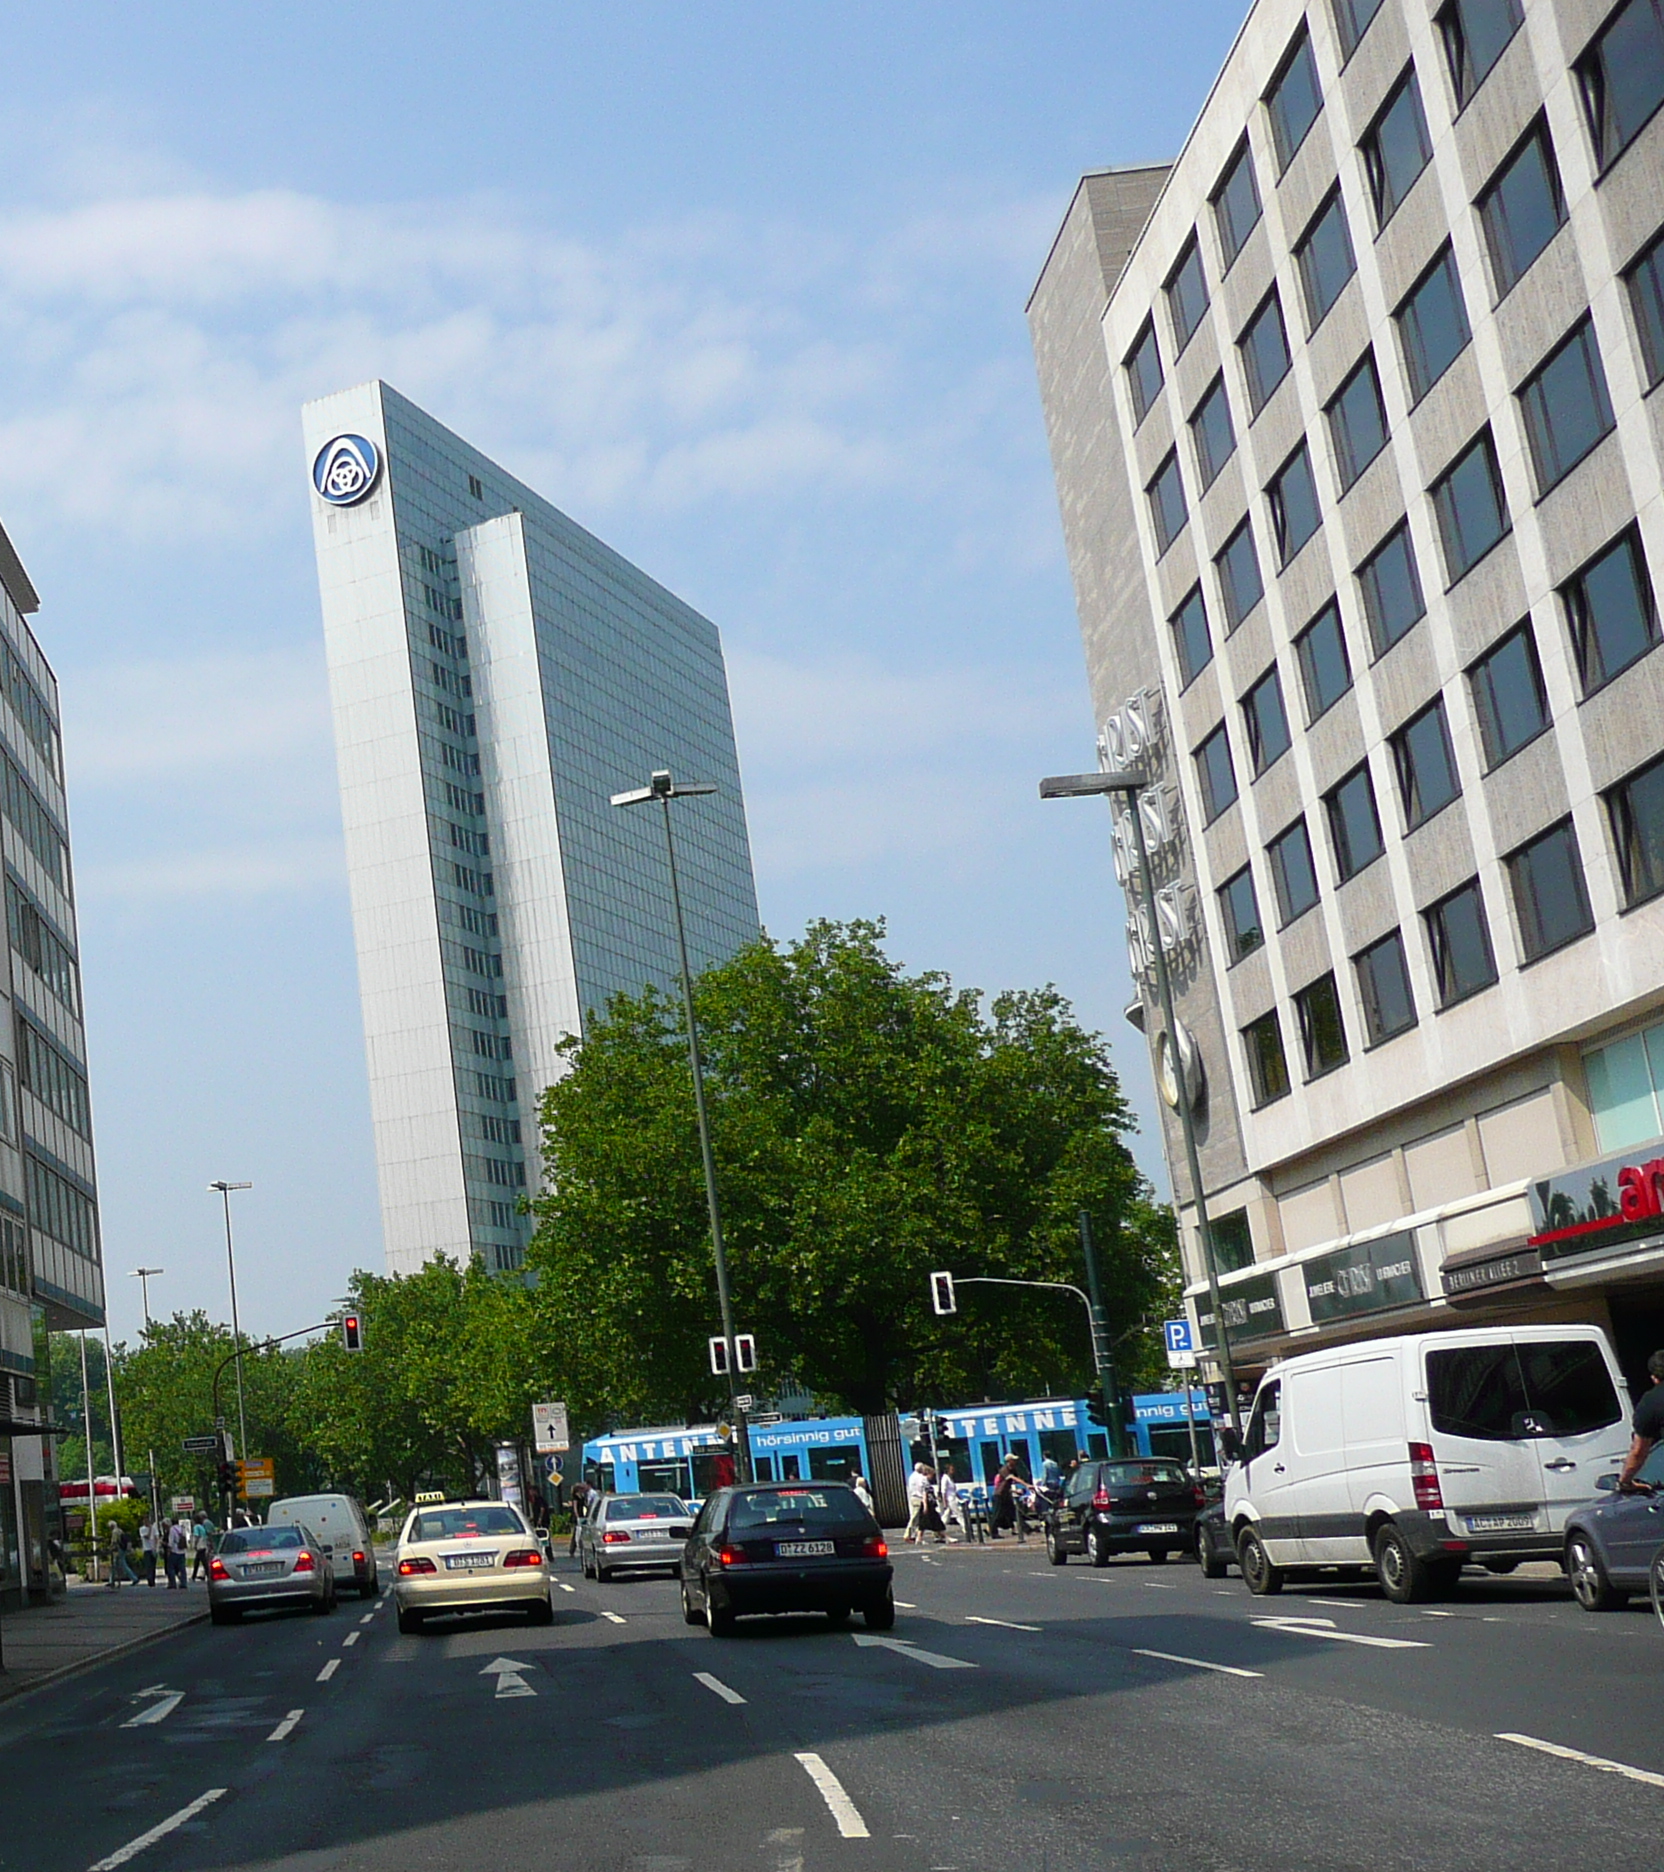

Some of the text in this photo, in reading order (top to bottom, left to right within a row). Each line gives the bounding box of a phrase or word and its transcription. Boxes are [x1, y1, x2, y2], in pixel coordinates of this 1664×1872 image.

[1448, 1261, 1520, 1289] BERLINER ALLEE 2
[1169, 1325, 1185, 1349] P
[756, 1426, 861, 1448] hörsinnig gut
[418, 1493, 441, 1501] TAXI
[808, 1542, 833, 1553] 6128
